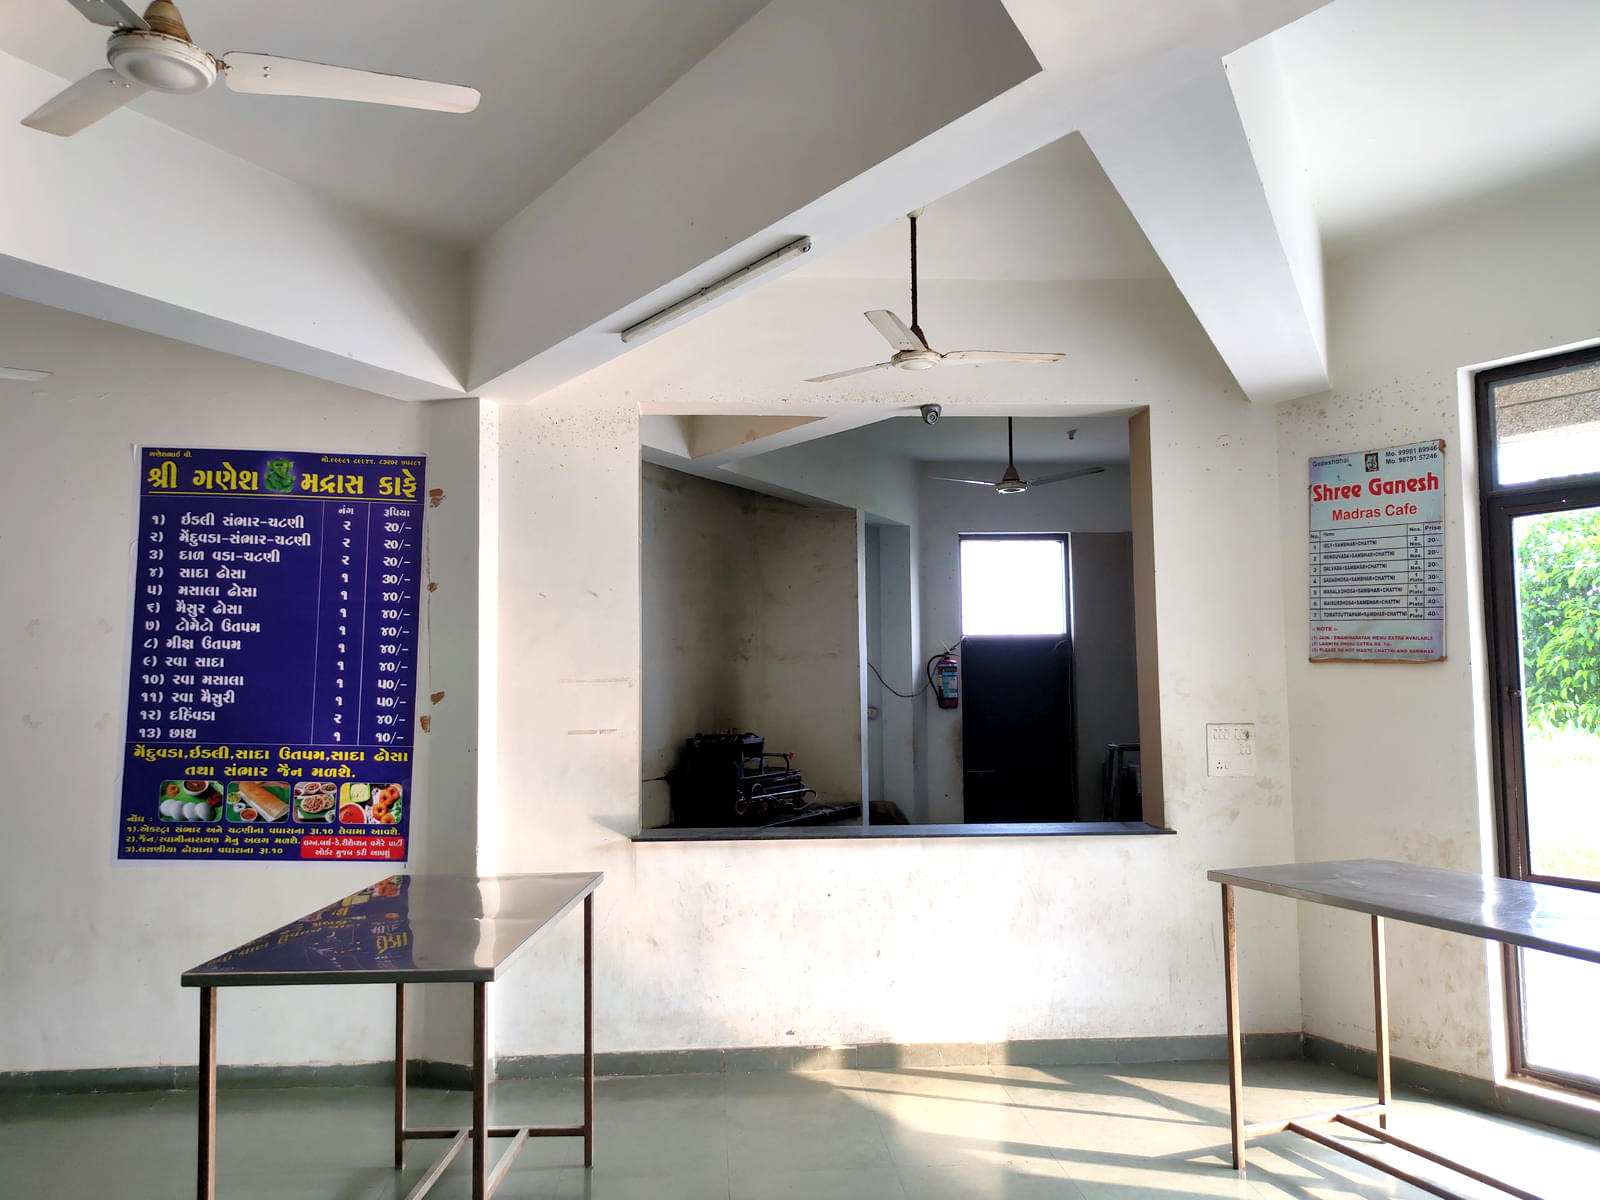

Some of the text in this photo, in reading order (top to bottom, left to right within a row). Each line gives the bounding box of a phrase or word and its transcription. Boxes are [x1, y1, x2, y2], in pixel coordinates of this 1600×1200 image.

[147, 461, 417, 498] શ્રી ગણેશ મદ્રાસ કાફે
[1313, 472, 1438, 502] Shree Ganesh
[338, 505, 353, 514] નંગ
[384, 507, 409, 517] રૂપિયા
[1332, 503, 1417, 521] Madras Cafe
[152, 512, 304, 528] ૧) ઇડલી સંભાર-ચટણી
[344, 521, 351, 530] ૨
[150, 532, 163, 542] ૨)
[343, 538, 350, 547] ૨
[149, 549, 280, 562] ૩) દાળ વડા-ચટણી
[342, 556, 349, 565] ૨
[149, 565, 245, 579] ૪) સાદા ઢોસા
[342, 573, 348, 582] ૧
[147, 583, 256, 597] ૫) મસાલા ઢોસા
[341, 591, 347, 600] ૧
[147, 600, 242, 618] ૬) મૈસુર ઢોસા
[340, 608, 346, 617] ૧
[145, 617, 260, 632] ૭) ટોમેટો ઉતપમ
[339, 626, 345, 635] ૧
[144, 636, 240, 650] ૮) મીક્ષ ઉતપમ
[338, 643, 345, 653] ૧
[143, 656, 224, 667] ૯) રવા સાદા
[337, 661, 344, 670] ૧
[142, 674, 243, 685] ૧૦) રવા મસાલા
[337, 679, 343, 688] ૧
[141, 689, 234, 707] ૧૧) રવા મૈસુરી
[336, 697, 342, 705] ૧
[140, 706, 217, 721] ૧૨) દહિંવડા
[334, 714, 341, 723] ૨
[139, 728, 196, 738] ૧૩) છાશ
[334, 732, 340, 741] ૧
[374, 748, 408, 761] ઢોસા
[185, 763, 355, 777] તથા સંભાર જૈન મળશે.
